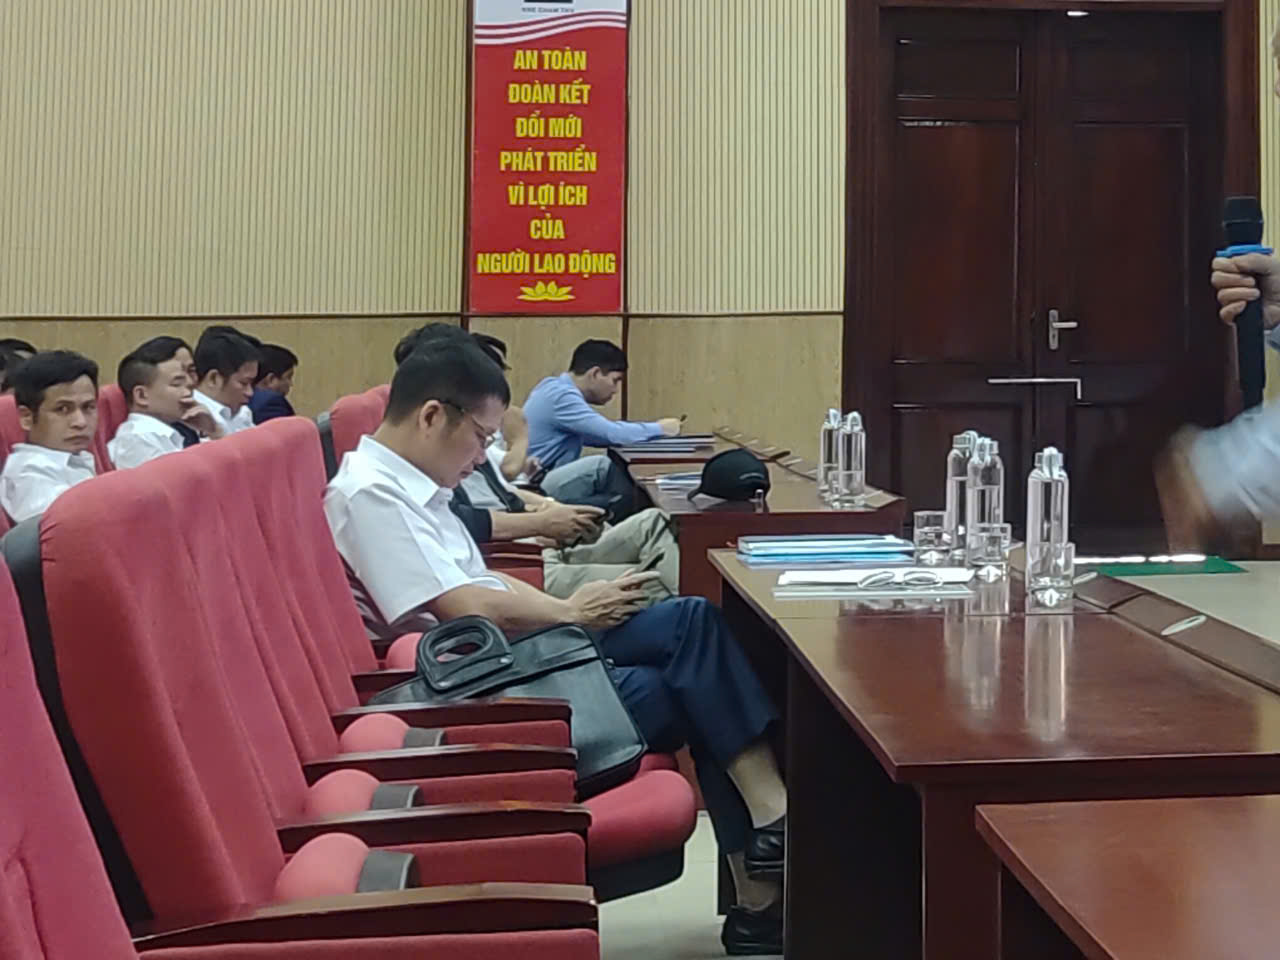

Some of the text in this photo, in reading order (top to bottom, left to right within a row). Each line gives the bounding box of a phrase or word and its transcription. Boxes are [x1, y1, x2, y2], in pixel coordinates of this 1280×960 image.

[514, 46, 587, 71] AN TOÀN
[508, 77, 592, 104] ĐOÀN KẾT
[515, 110, 582, 137] ĐỔI MỚI
[500, 143, 597, 172] PHÁT TRIỂN
[508, 181, 588, 210] VÌ LỢI ÍCH
[530, 213, 565, 239] CỦA
[477, 248, 616, 278] NGƯỜI LAO ĐỘNG
